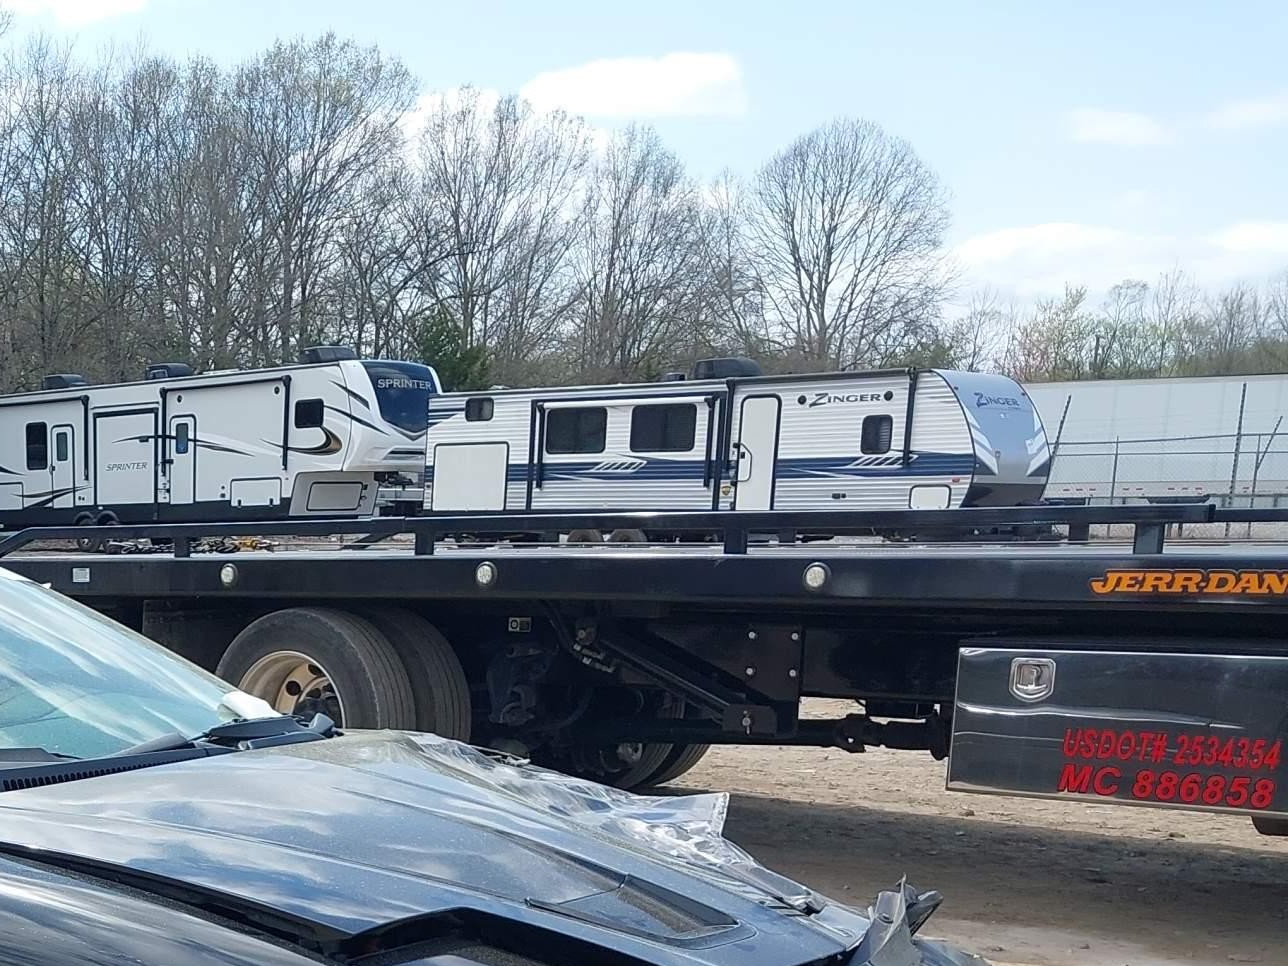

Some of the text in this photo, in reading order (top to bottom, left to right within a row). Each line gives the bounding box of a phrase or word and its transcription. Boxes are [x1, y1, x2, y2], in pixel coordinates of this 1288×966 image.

[377, 378, 432, 390] SPRINTER
[105, 462, 148, 471] SPRINTER
[1063, 728, 1282, 770] USDOT# 2534354
[1057, 763, 1275, 808] MC 886858
